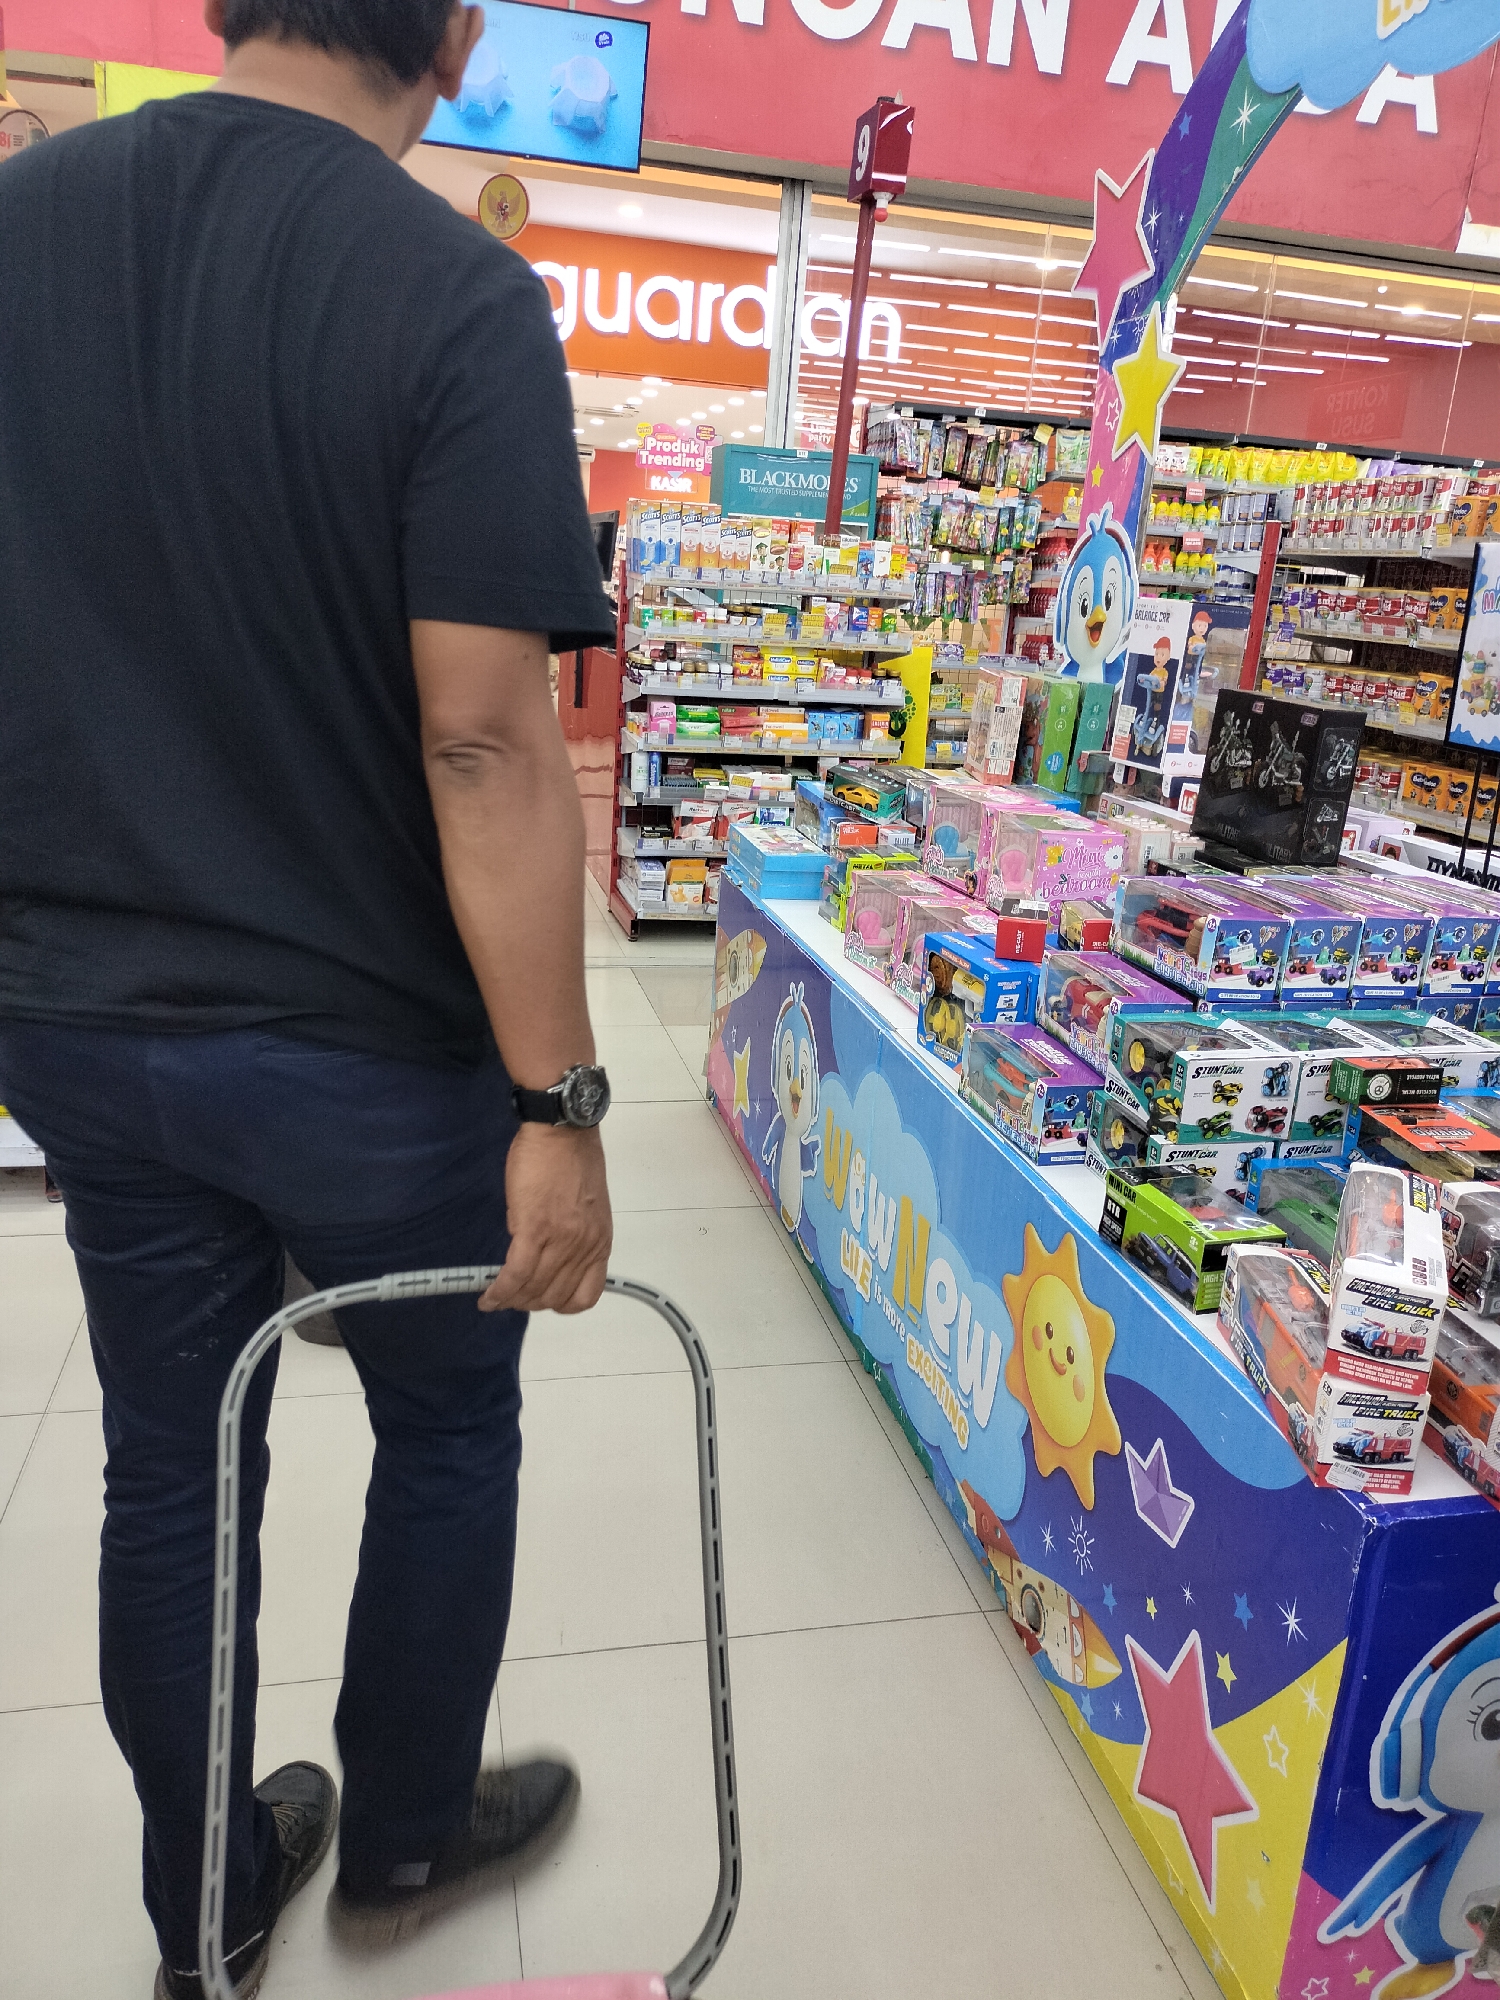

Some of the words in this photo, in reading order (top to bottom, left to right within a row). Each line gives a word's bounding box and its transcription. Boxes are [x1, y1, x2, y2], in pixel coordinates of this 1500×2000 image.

[855, 124, 869, 182] 9
[532, 260, 901, 363] guardan
[646, 436, 700, 455] Produk
[639, 450, 704, 472] Trending
[739, 468, 859, 493] BLACKMOES
[799, 490, 830, 499] SUPPLEMEN
[1042, 875, 1113, 899] bedroom
[1191, 1065, 1227, 1079] STUNT
[1224, 1065, 1245, 1075] CAR
[1306, 1065, 1332, 1078] STU
[1105, 1079, 1130, 1103] STUNT
[1126, 1095, 1141, 1112] CAR
[1166, 1150, 1202, 1163] STUNT
[1198, 1151, 1219, 1159] CAR
[1284, 1145, 1318, 1159] STUNT
[1314, 1146, 1333, 1154] CAR
[1086, 1154, 1107, 1177] STUNT
[1108, 1173, 1123, 1194] MINI
[1123, 1186, 1137, 1204] CAR
[1203, 1273, 1219, 1283] HIGH
[1364, 1295, 1392, 1310] FIRE
[1394, 1302, 1436, 1318] TRUCK
[841, 1229, 872, 1302] LIFE
[874, 1278, 882, 1305] is
[883, 1301, 906, 1343] more
[906, 1332, 969, 1451] EXCITING
[1230, 1328, 1246, 1360] FIRE
[1245, 1355, 1268, 1395] TRUCK
[1355, 1407, 1383, 1417] FIRE
[1383, 1409, 1421, 1420] TRUCK
